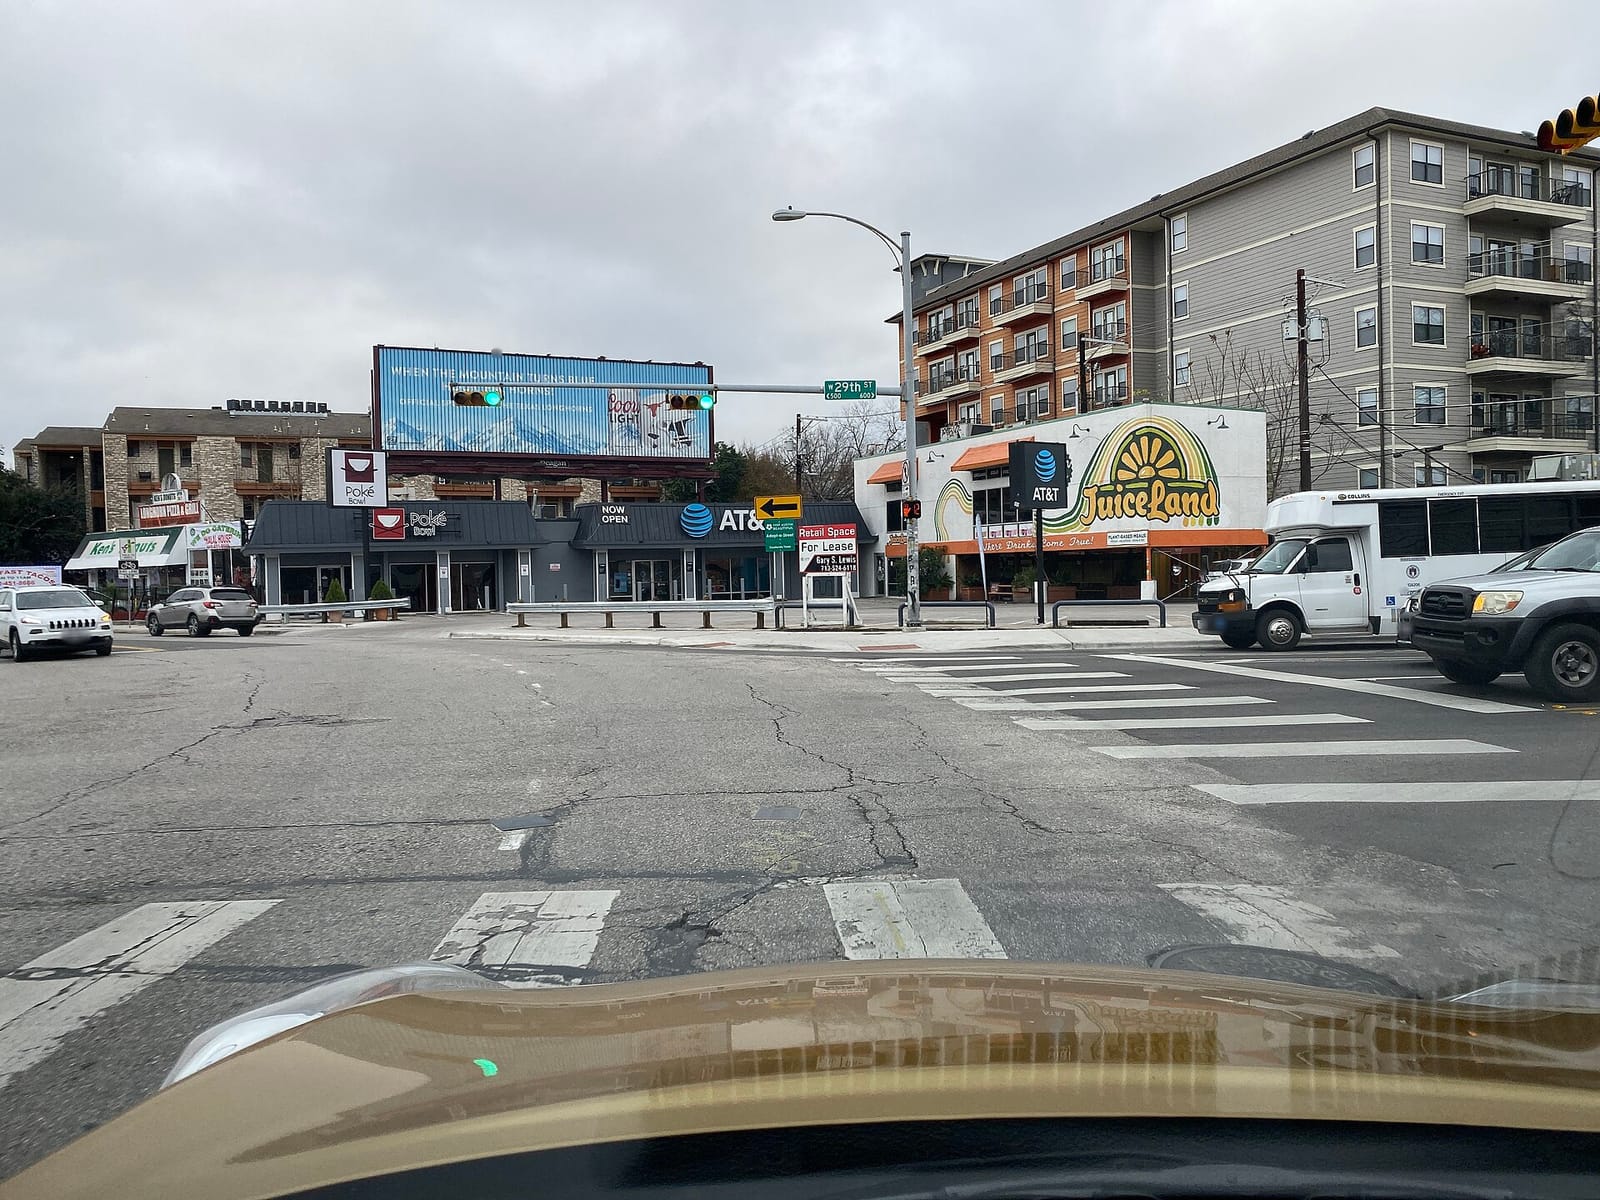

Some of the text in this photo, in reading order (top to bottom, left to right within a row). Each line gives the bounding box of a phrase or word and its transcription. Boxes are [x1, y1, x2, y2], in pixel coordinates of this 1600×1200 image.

[391, 366, 429, 377] WHEN
[433, 368, 455, 378] THE
[459, 369, 523, 381] MOUNTAIN
[527, 373, 565, 383] TURNS
[834, 382, 861, 393] 29th
[610, 413, 640, 424] LIGHT
[345, 484, 375, 498] Poké
[1032, 487, 1060, 502] AT&T
[348, 497, 366, 505] Bowl
[1080, 477, 1220, 526] JuiceLand
[601, 505, 625, 514] NOW
[409, 509, 447, 527] Poké
[601, 515, 628, 523] OPEN
[719, 509, 766, 531] AT&
[413, 526, 436, 537] Bowl
[799, 527, 856, 539] Retail Space
[90, 540, 116, 556] Ken's
[135, 541, 157, 553] nuts
[801, 541, 854, 553] For Lease
